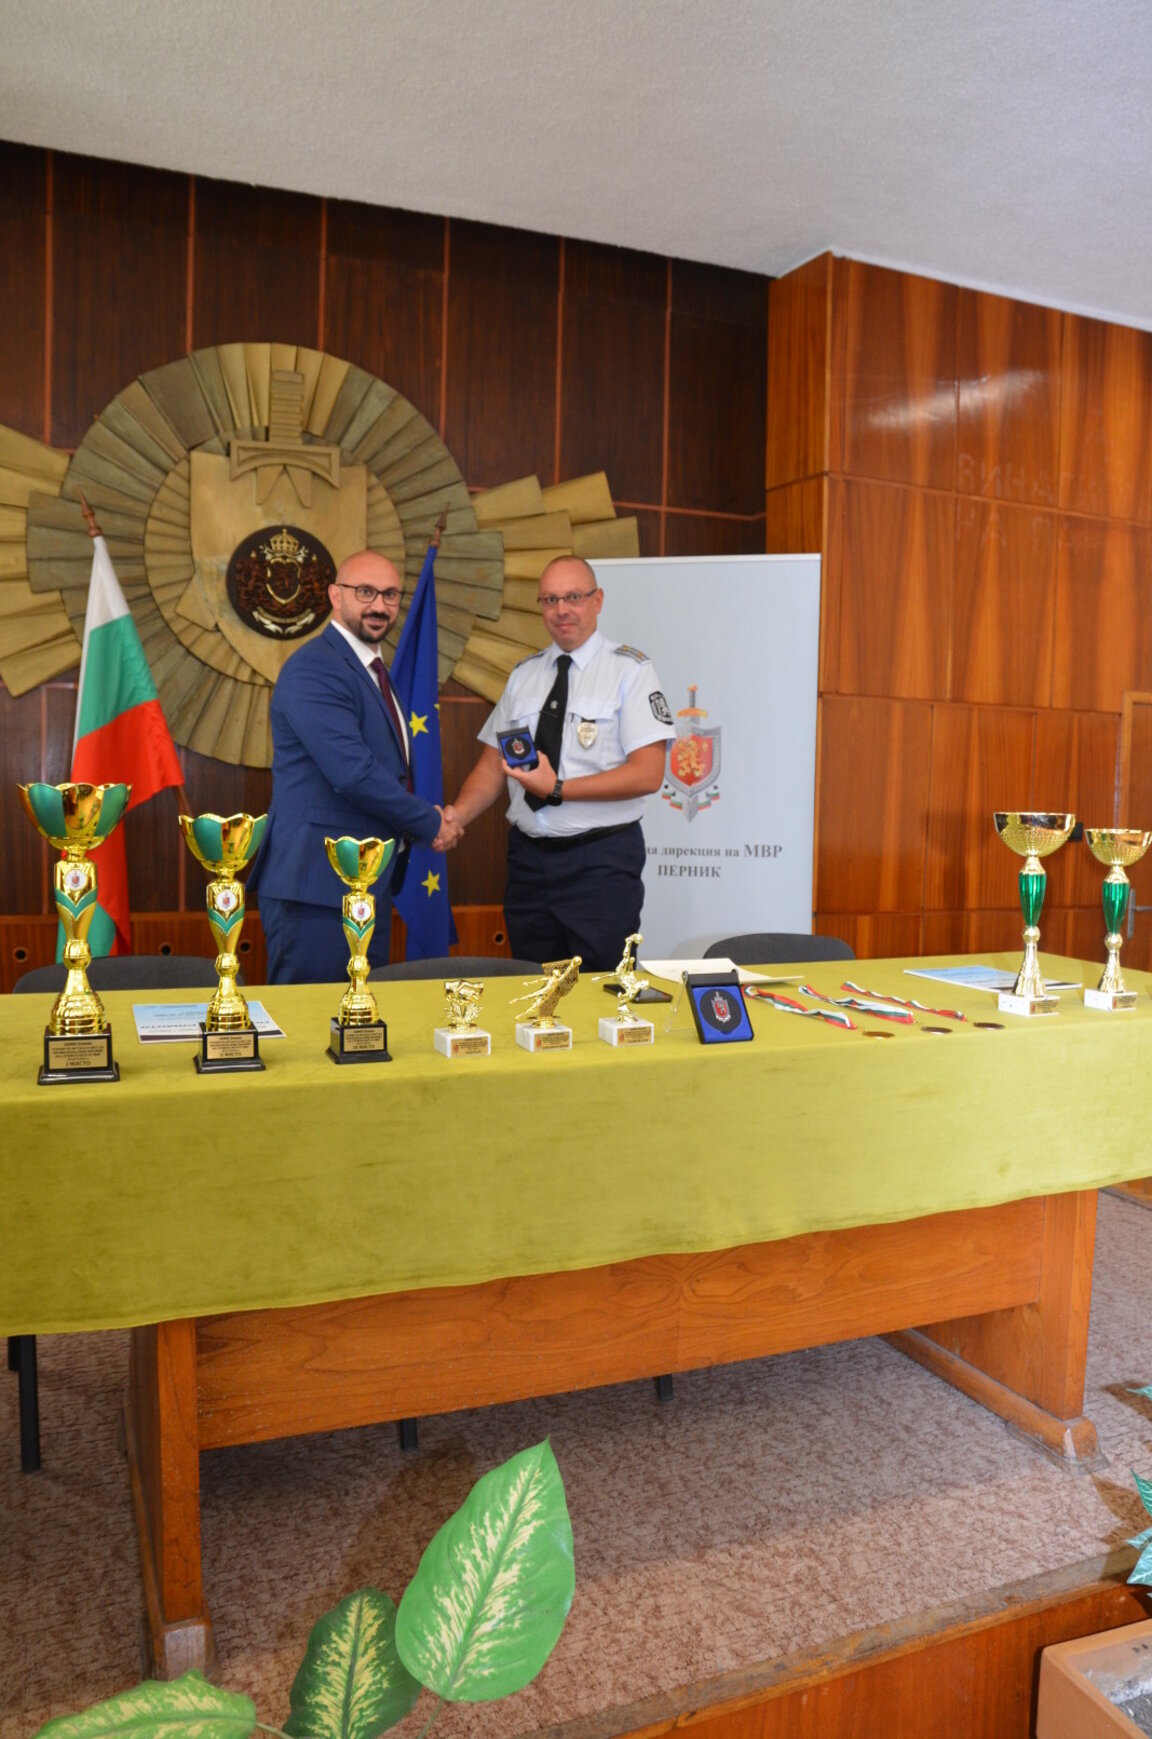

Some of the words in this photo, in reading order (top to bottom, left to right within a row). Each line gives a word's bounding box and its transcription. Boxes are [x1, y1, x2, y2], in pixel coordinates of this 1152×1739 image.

[660, 846, 721, 859] дирекция
[724, 847, 740, 857] на
[744, 843, 783, 858] МВР
[657, 864, 722, 878] ПЕРНИК
